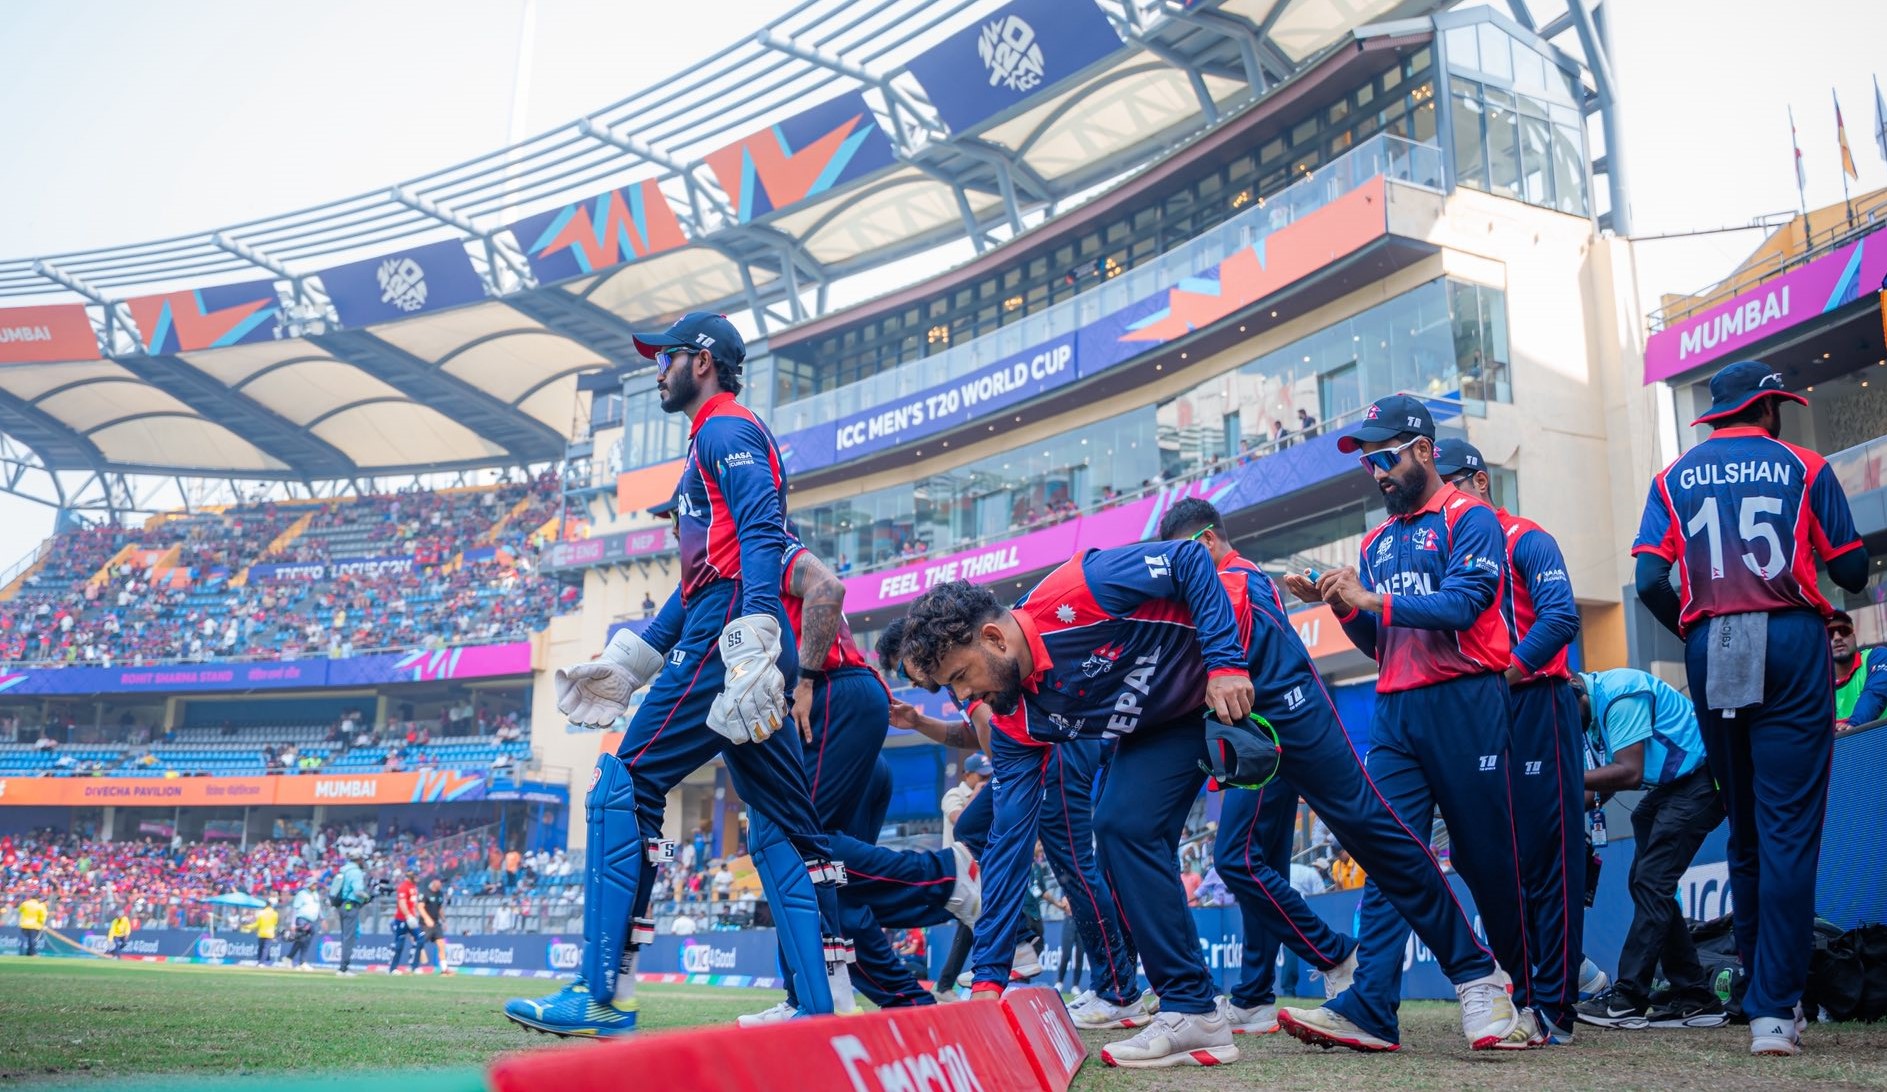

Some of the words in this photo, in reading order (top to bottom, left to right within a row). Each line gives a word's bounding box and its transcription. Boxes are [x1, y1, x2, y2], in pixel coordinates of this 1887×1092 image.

[0, 326, 52, 343] UMBAI
[1680, 285, 1789, 360] MUMBAI
[836, 421, 866, 450] ICC
[868, 402, 924, 439] MEN'S
[926, 388, 960, 420] T20
[961, 362, 1029, 408] WORLD
[1031, 344, 1072, 380] CUP
[1680, 461, 1790, 489] GULSHAN
[1687, 496, 1786, 580] 15
[879, 571, 920, 599] FEEL
[925, 561, 959, 588] THE
[961, 546, 1020, 578] THRILL
[1375, 571, 1440, 597] NEPAL
[727, 630, 742, 648] SS
[134, 786, 182, 796] PAVILION
[315, 779, 376, 798] MUMBAI
